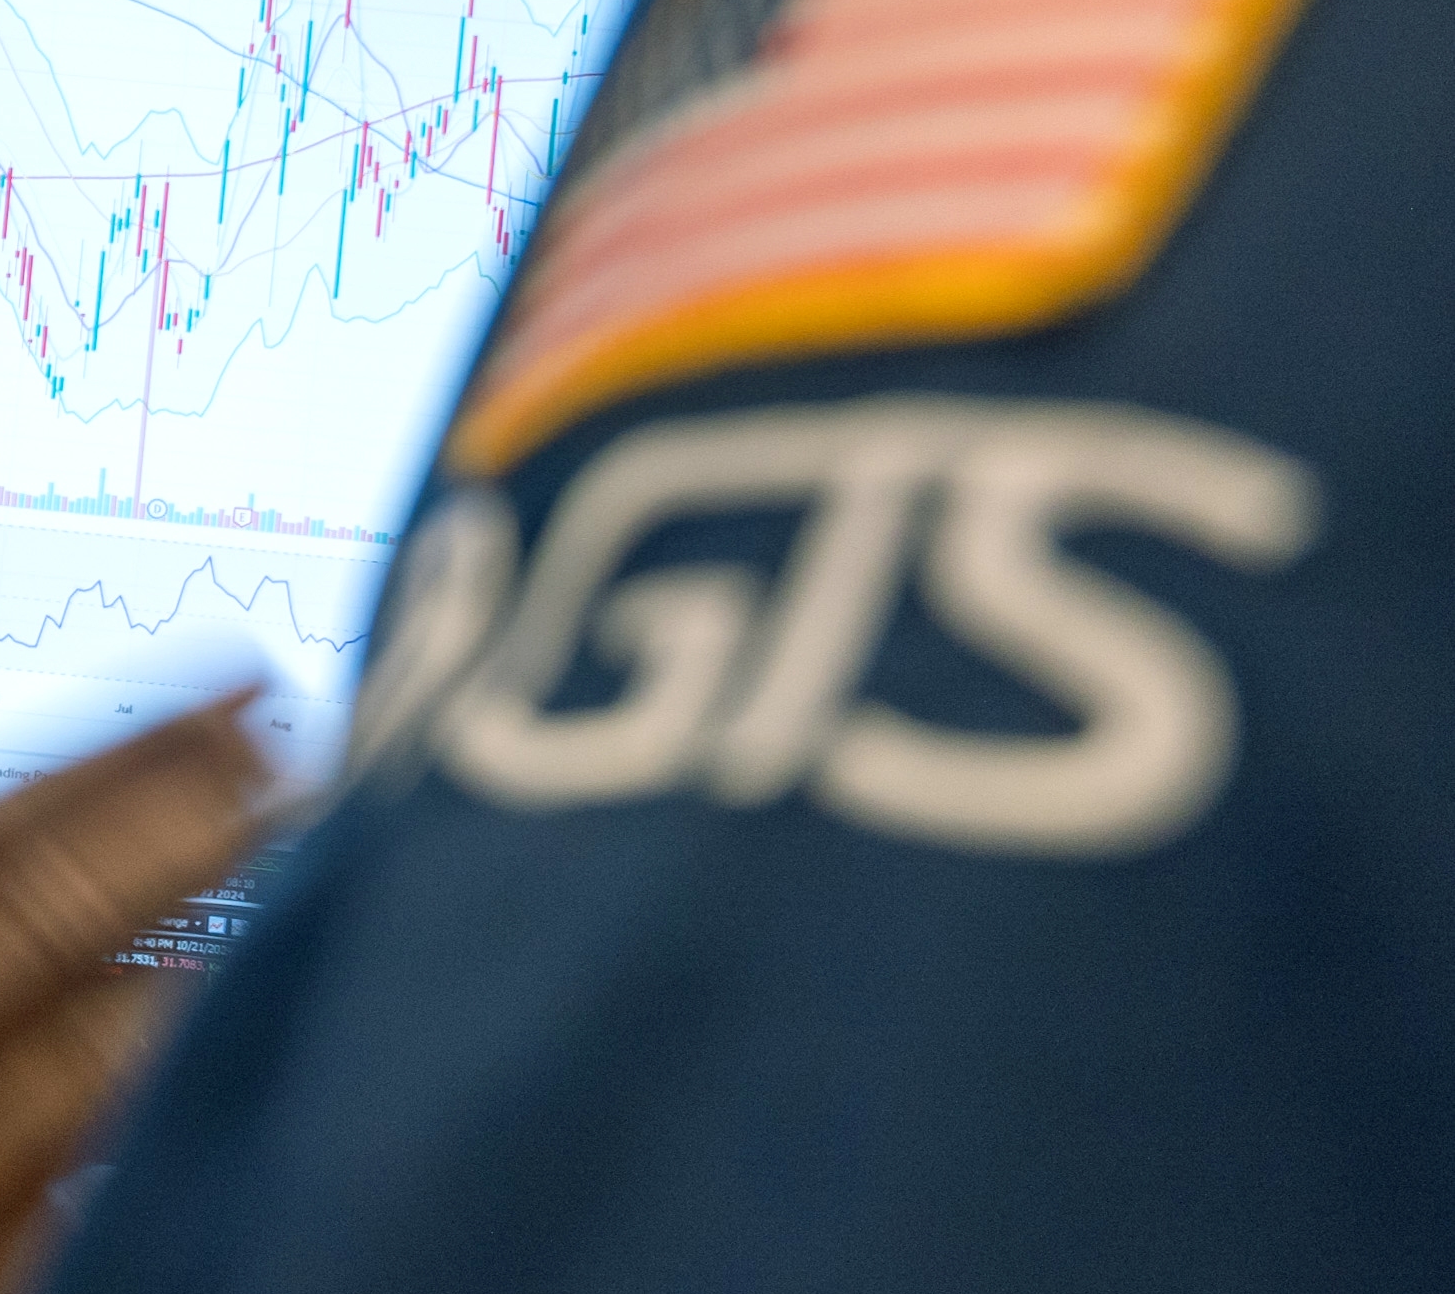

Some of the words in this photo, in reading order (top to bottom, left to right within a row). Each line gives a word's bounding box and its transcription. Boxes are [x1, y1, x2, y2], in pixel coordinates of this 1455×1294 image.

[437, 391, 1326, 858] GTS
[114, 703, 133, 715] Jul
[269, 718, 292, 732] Aug
[216, 890, 245, 901] 2024
[157, 940, 174, 950] PM
